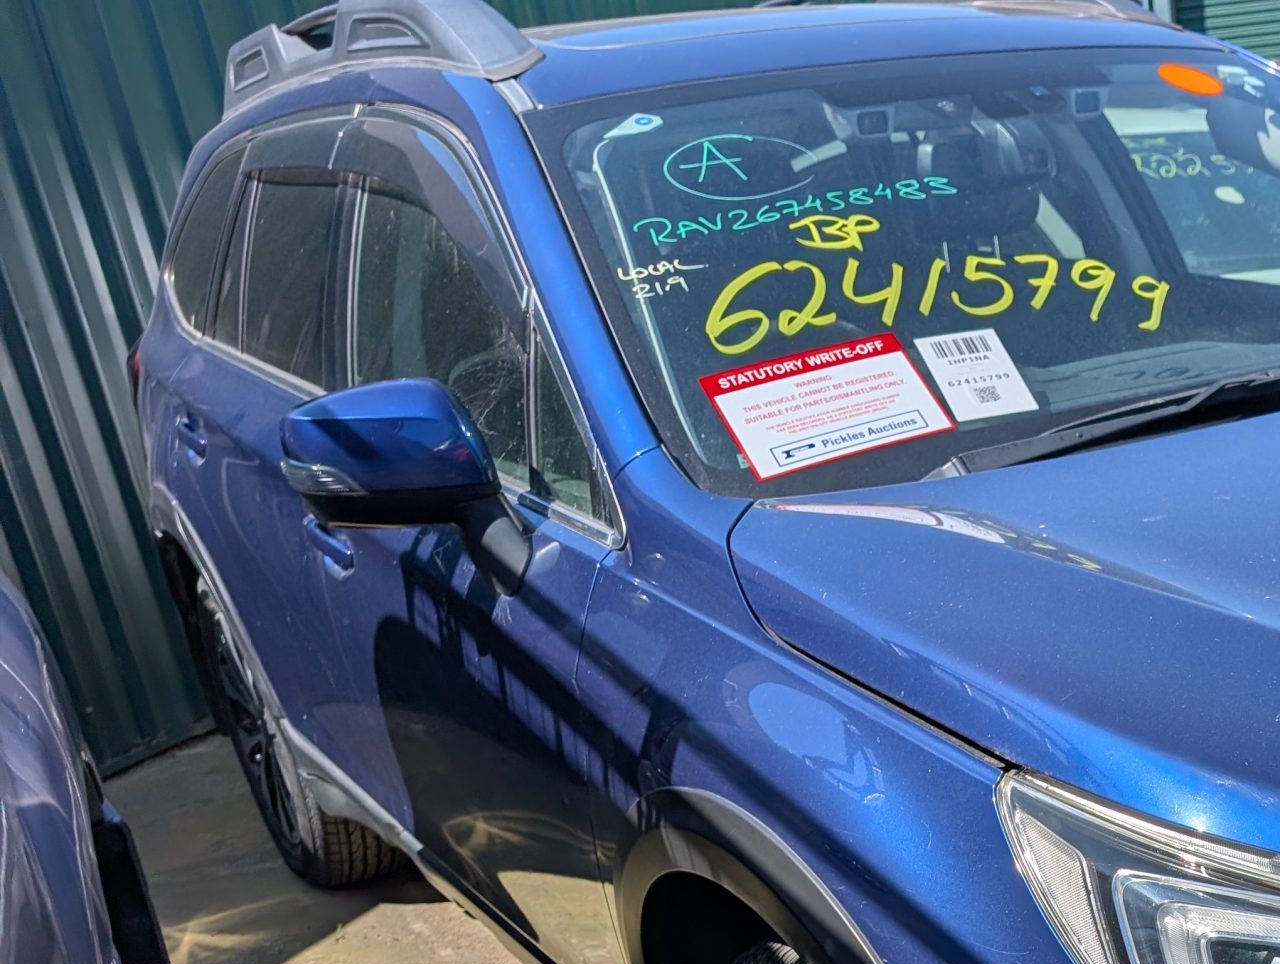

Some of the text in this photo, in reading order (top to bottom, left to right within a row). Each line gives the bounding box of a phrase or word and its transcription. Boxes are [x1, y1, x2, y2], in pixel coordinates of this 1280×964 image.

[679, 141, 748, 182] A
[633, 177, 958, 246] RAV267458483
[718, 340, 884, 390] STATUTORY WRITE-OFF
[947, 373, 1010, 387] 62415799
[742, 403, 762, 414] THIS
[762, 394, 799, 409] VEHICLE
[798, 386, 832, 399] CANNOT
[831, 382, 844, 390] BE
[744, 410, 785, 425] SUITABLE
[785, 404, 802, 415] FOR
[821, 429, 866, 449] Pickles
[867, 417, 918, 437] Auctions
